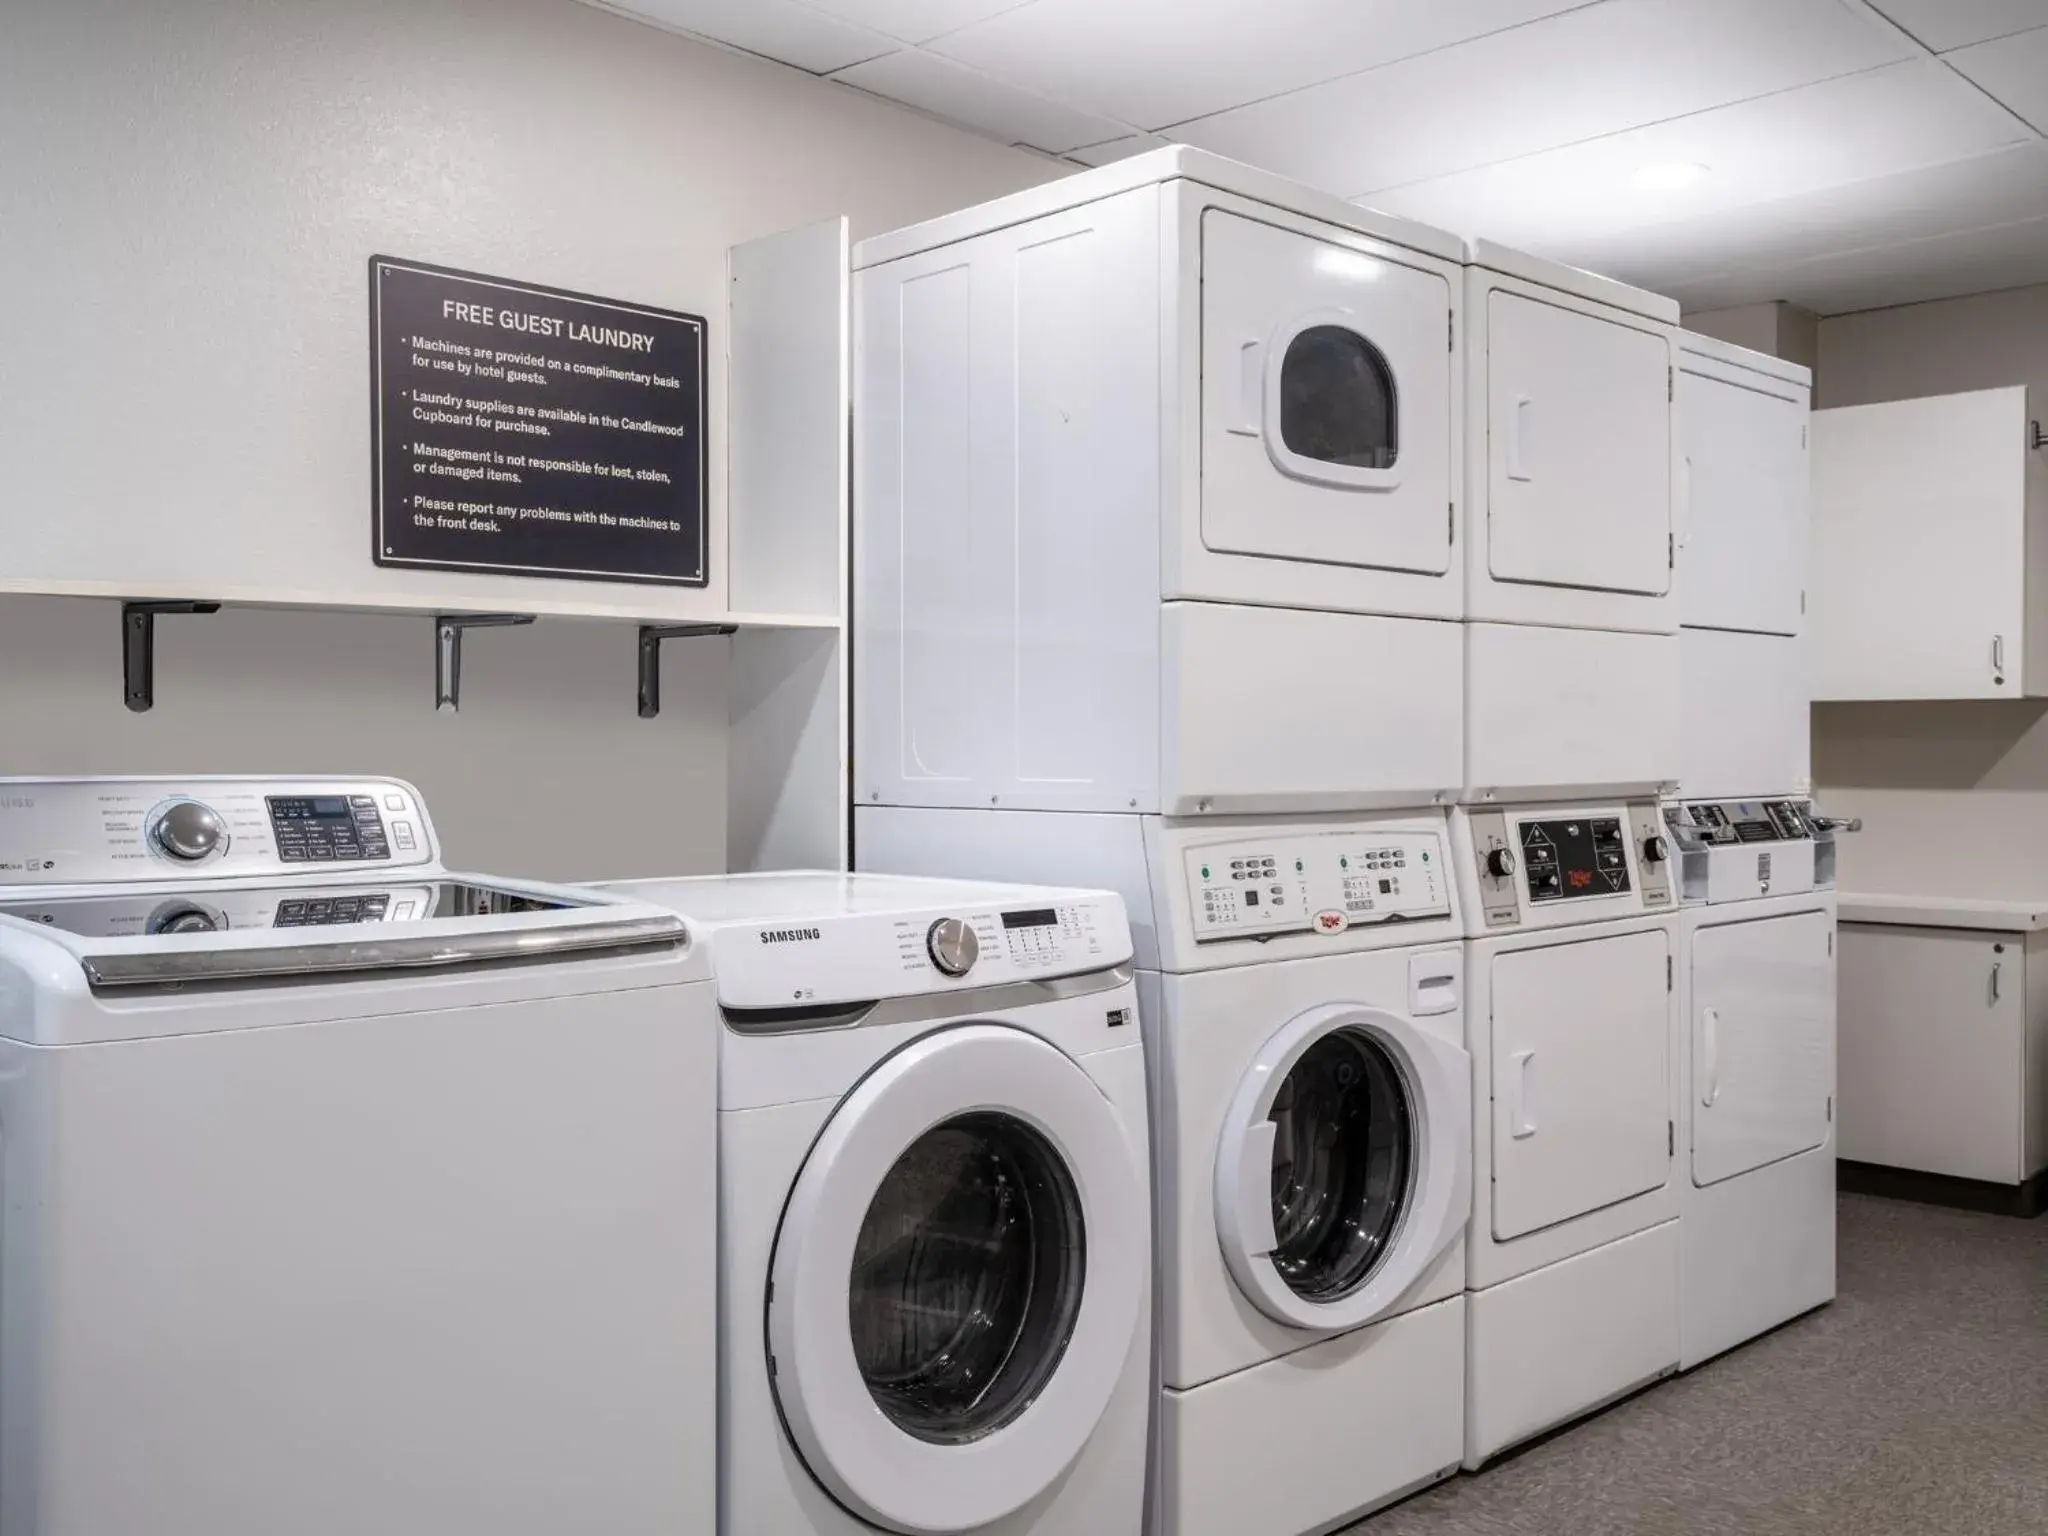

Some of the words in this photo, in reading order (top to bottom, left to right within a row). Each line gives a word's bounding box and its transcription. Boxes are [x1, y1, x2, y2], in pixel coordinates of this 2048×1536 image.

[443, 300, 494, 325] FREE
[499, 310, 564, 337] GUEST
[569, 321, 655, 353] LAUNDRY
[412, 336, 472, 355] Machines
[474, 349, 493, 358] are
[496, 352, 545, 368] provided
[547, 359, 561, 369] on
[564, 362, 570, 371] a
[573, 363, 652, 386] complimentary
[653, 373, 680, 388] basis
[412, 353, 430, 367] for
[433, 360, 454, 371] use
[457, 362, 472, 376] by
[475, 362, 504, 378] hotel
[506, 369, 547, 385] guests.
[412, 406, 473, 426] Cupboard
[475, 414, 492, 428] for
[495, 420, 551, 436] purchase.
[413, 389, 463, 408] Laundry
[465, 397, 514, 415] supplies
[517, 406, 535, 417] are
[537, 409, 587, 424] available
[589, 414, 599, 425] in
[602, 415, 619, 428] the
[620, 418, 684, 436] Candlewood
[413, 442, 492, 462] Management
[494, 451, 504, 464] is
[506, 455, 526, 466] not
[528, 458, 592, 474] responsible
[594, 463, 609, 475] for
[611, 464, 635, 480] lost,
[636, 469, 671, 484] stolen,
[413, 463, 427, 473] or
[430, 462, 485, 480] damaged
[487, 468, 522, 482] items.
[413, 513, 435, 527] the
[437, 515, 467, 529] front
[469, 518, 501, 532] desk.
[414, 495, 455, 511] Please
[457, 502, 494, 515] report
[496, 506, 517, 519] any
[520, 507, 571, 521] problems
[573, 511, 596, 523] with
[599, 513, 617, 525] the
[619, 516, 668, 530] machines
[670, 520, 680, 531] to
[760, 928, 820, 944] SAMSUNG
